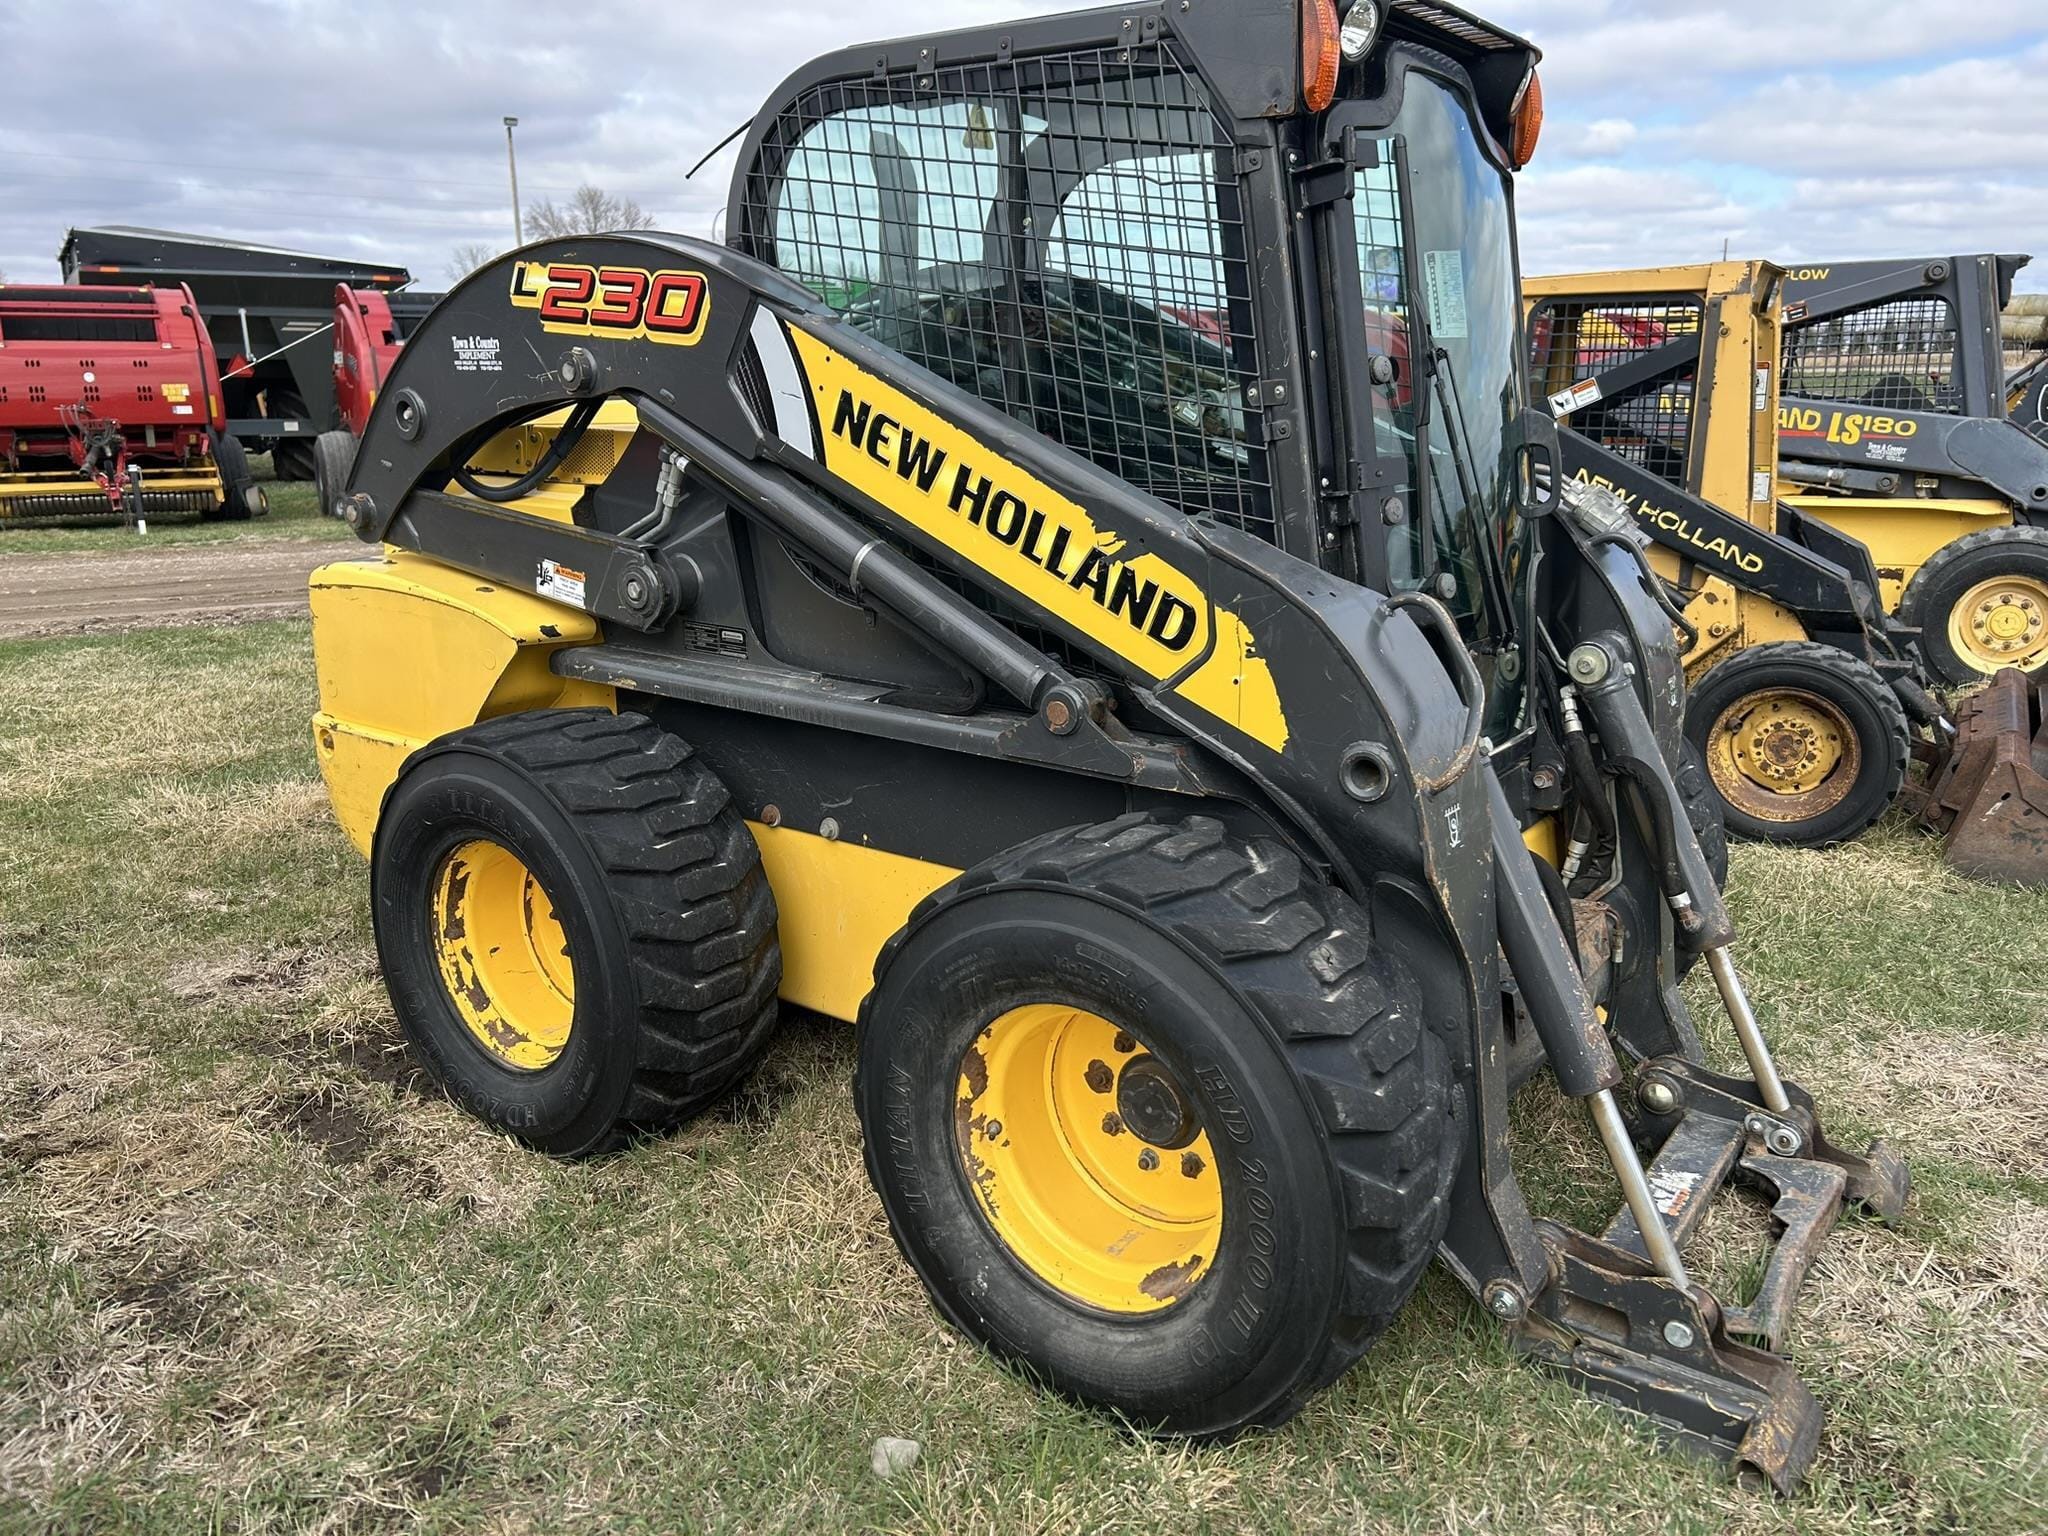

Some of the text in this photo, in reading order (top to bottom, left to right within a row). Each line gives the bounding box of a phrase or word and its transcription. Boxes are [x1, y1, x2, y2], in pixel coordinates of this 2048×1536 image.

[511, 265, 709, 337] L230
[831, 388, 1197, 652] NEW HOLLAND
[1637, 500, 1764, 573] HOLLAND
[885, 1057, 932, 1214] TITAN
[1195, 1063, 1254, 1144] HD
[1238, 1155, 1277, 1289] 2000
